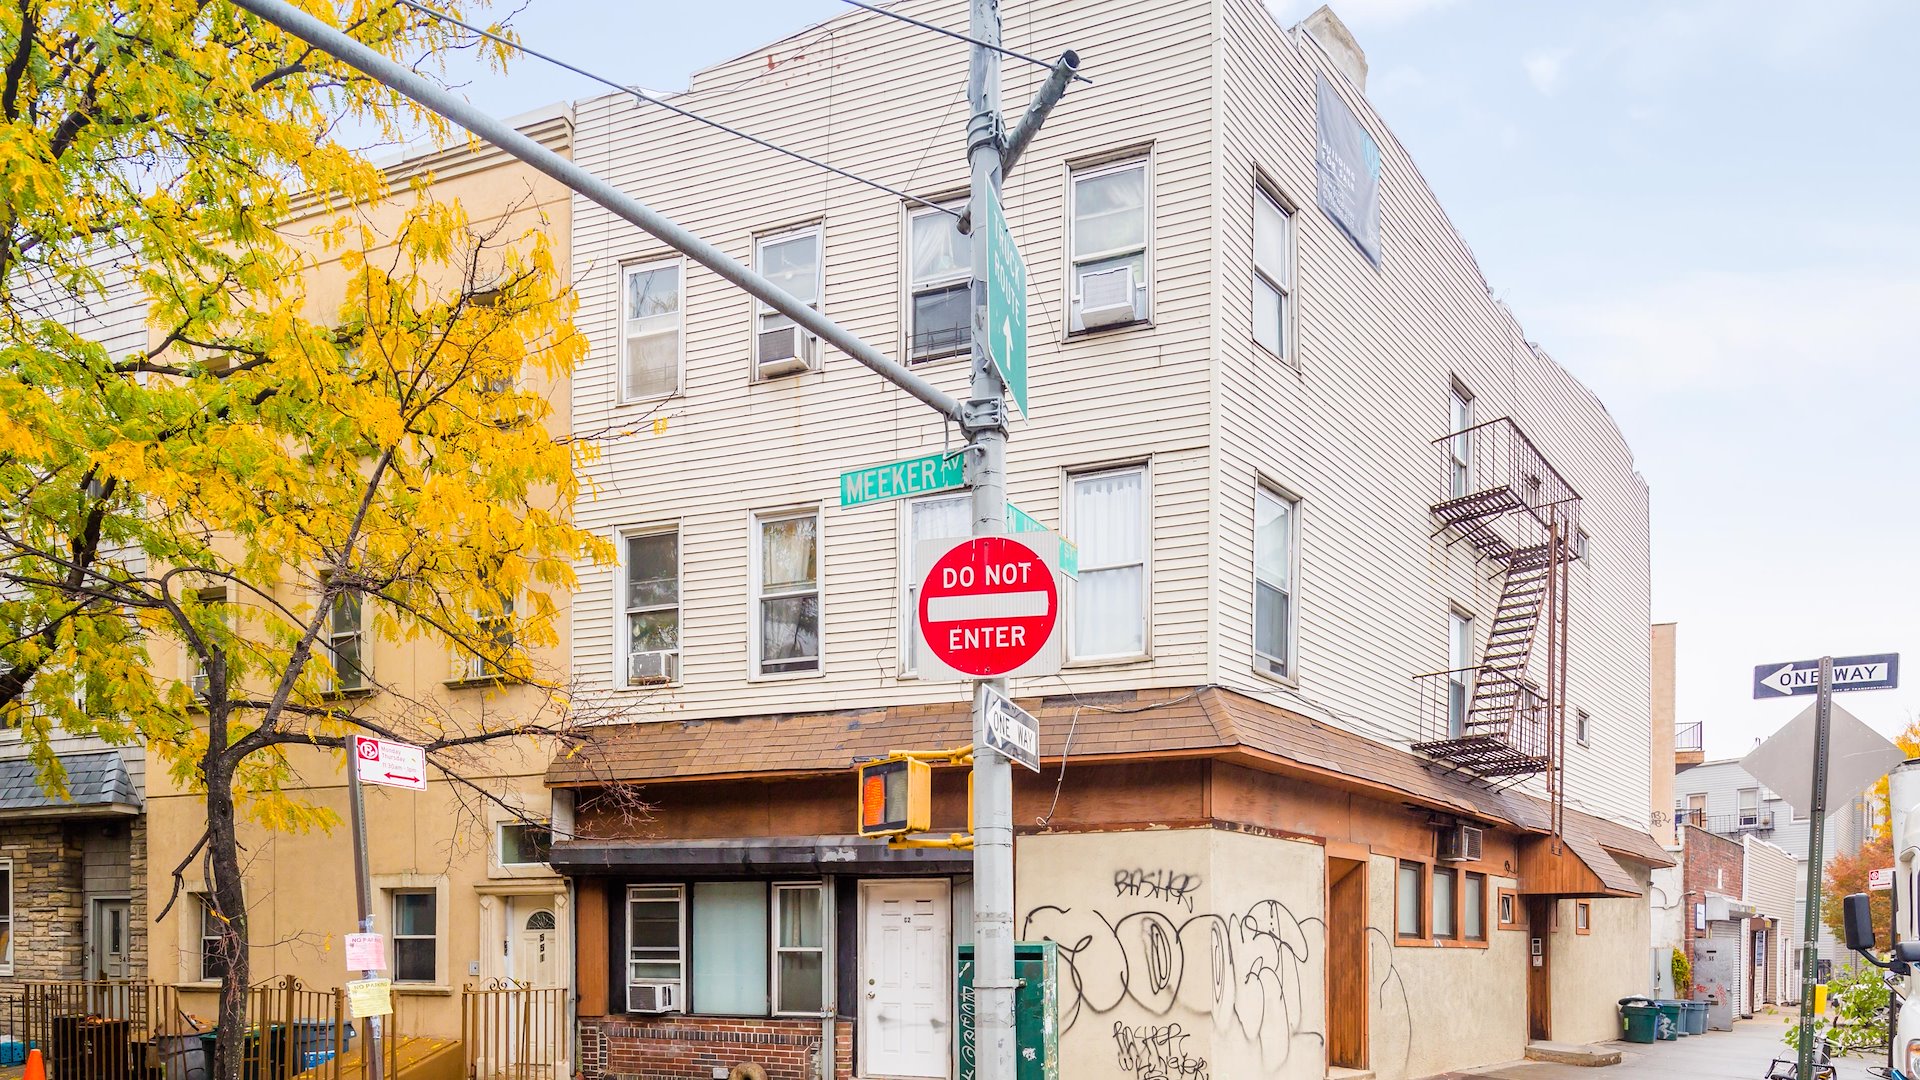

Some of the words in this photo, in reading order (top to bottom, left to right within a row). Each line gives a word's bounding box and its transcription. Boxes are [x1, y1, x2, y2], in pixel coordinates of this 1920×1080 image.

[1322, 139, 1356, 183] BUILDING
[1322, 150, 1336, 172] FOR
[1339, 168, 1355, 192] SALE
[994, 209, 1020, 292] TRUCK
[994, 249, 1020, 328] ROUTE
[846, 459, 937, 504] MEEKER
[940, 455, 961, 473] AV
[942, 566, 975, 589] DO
[985, 562, 1032, 586] NOT
[949, 625, 1026, 650] ENTER
[1779, 671, 1819, 687] ONE
[1834, 665, 1878, 682] WAY
[381, 746, 402, 755] Monday
[993, 710, 1011, 739] ONE
[1018, 724, 1033, 752] WAY
[382, 753, 406, 762] Thursday
